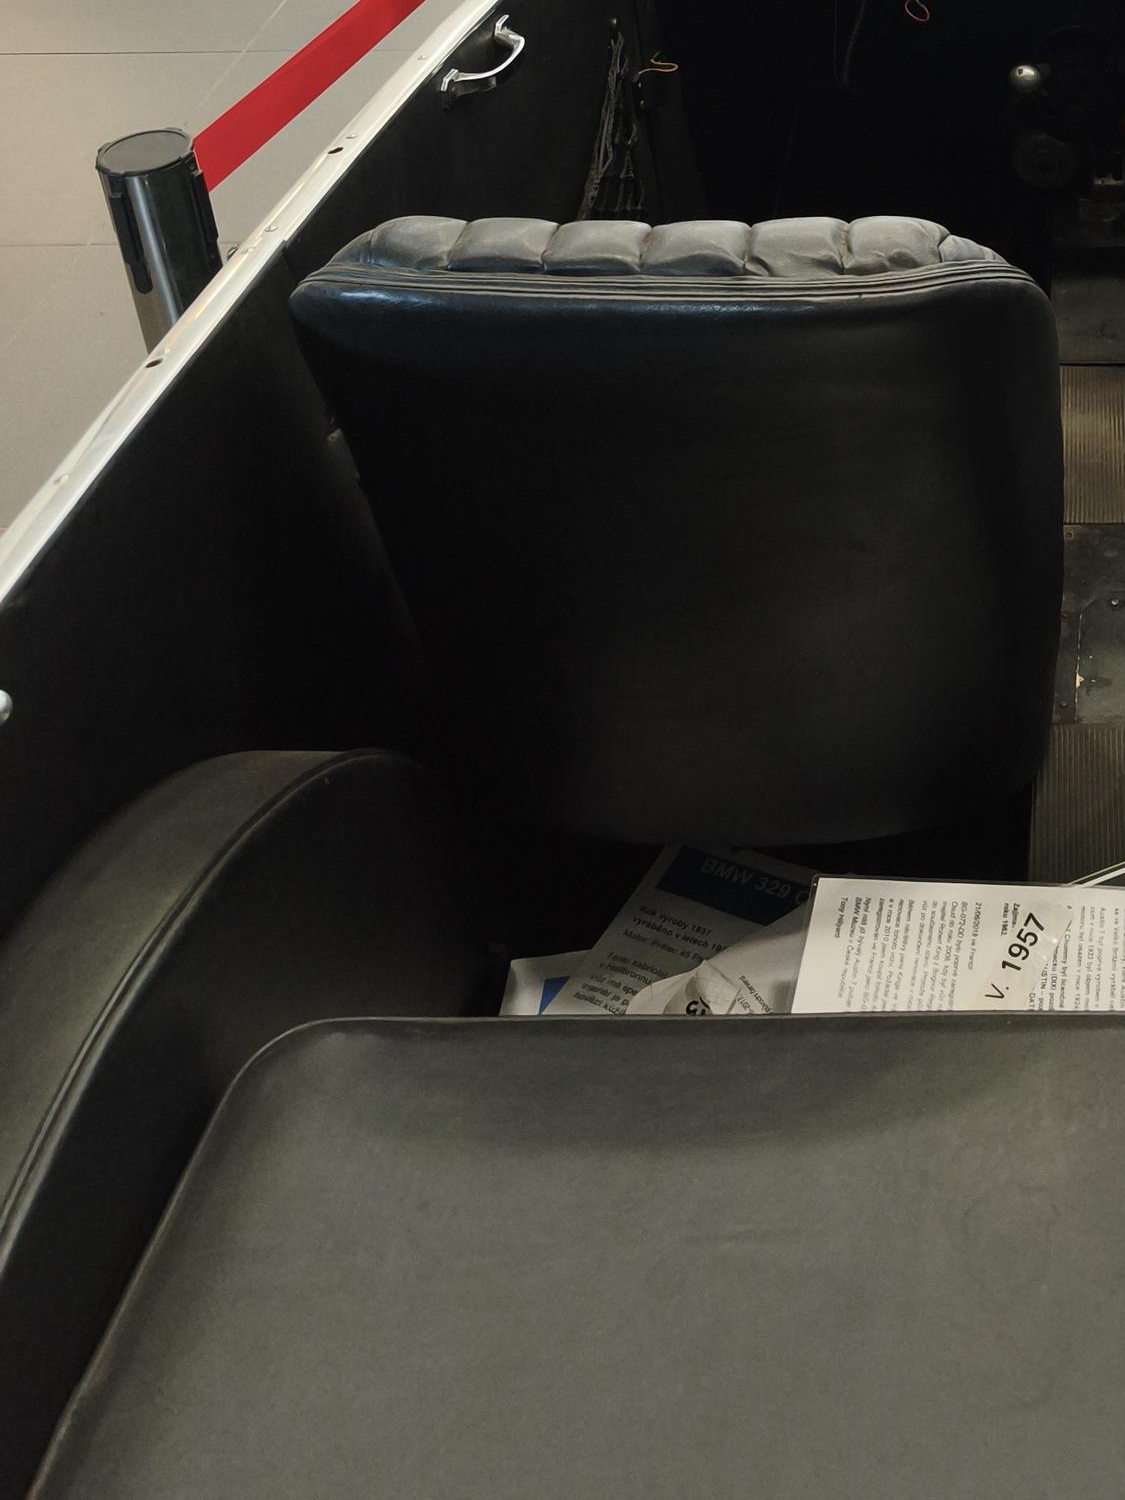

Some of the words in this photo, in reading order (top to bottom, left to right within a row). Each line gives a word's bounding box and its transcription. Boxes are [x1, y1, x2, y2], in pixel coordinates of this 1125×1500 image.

[701, 857, 755, 885] BMW
[754, 876, 792, 899] 329
[854, 897, 862, 915] BMW
[660, 913, 688, 930] výroby
[681, 933, 708, 948] letech
[883, 925, 891, 941] 2010
[1002, 913, 1044, 971] 1957
